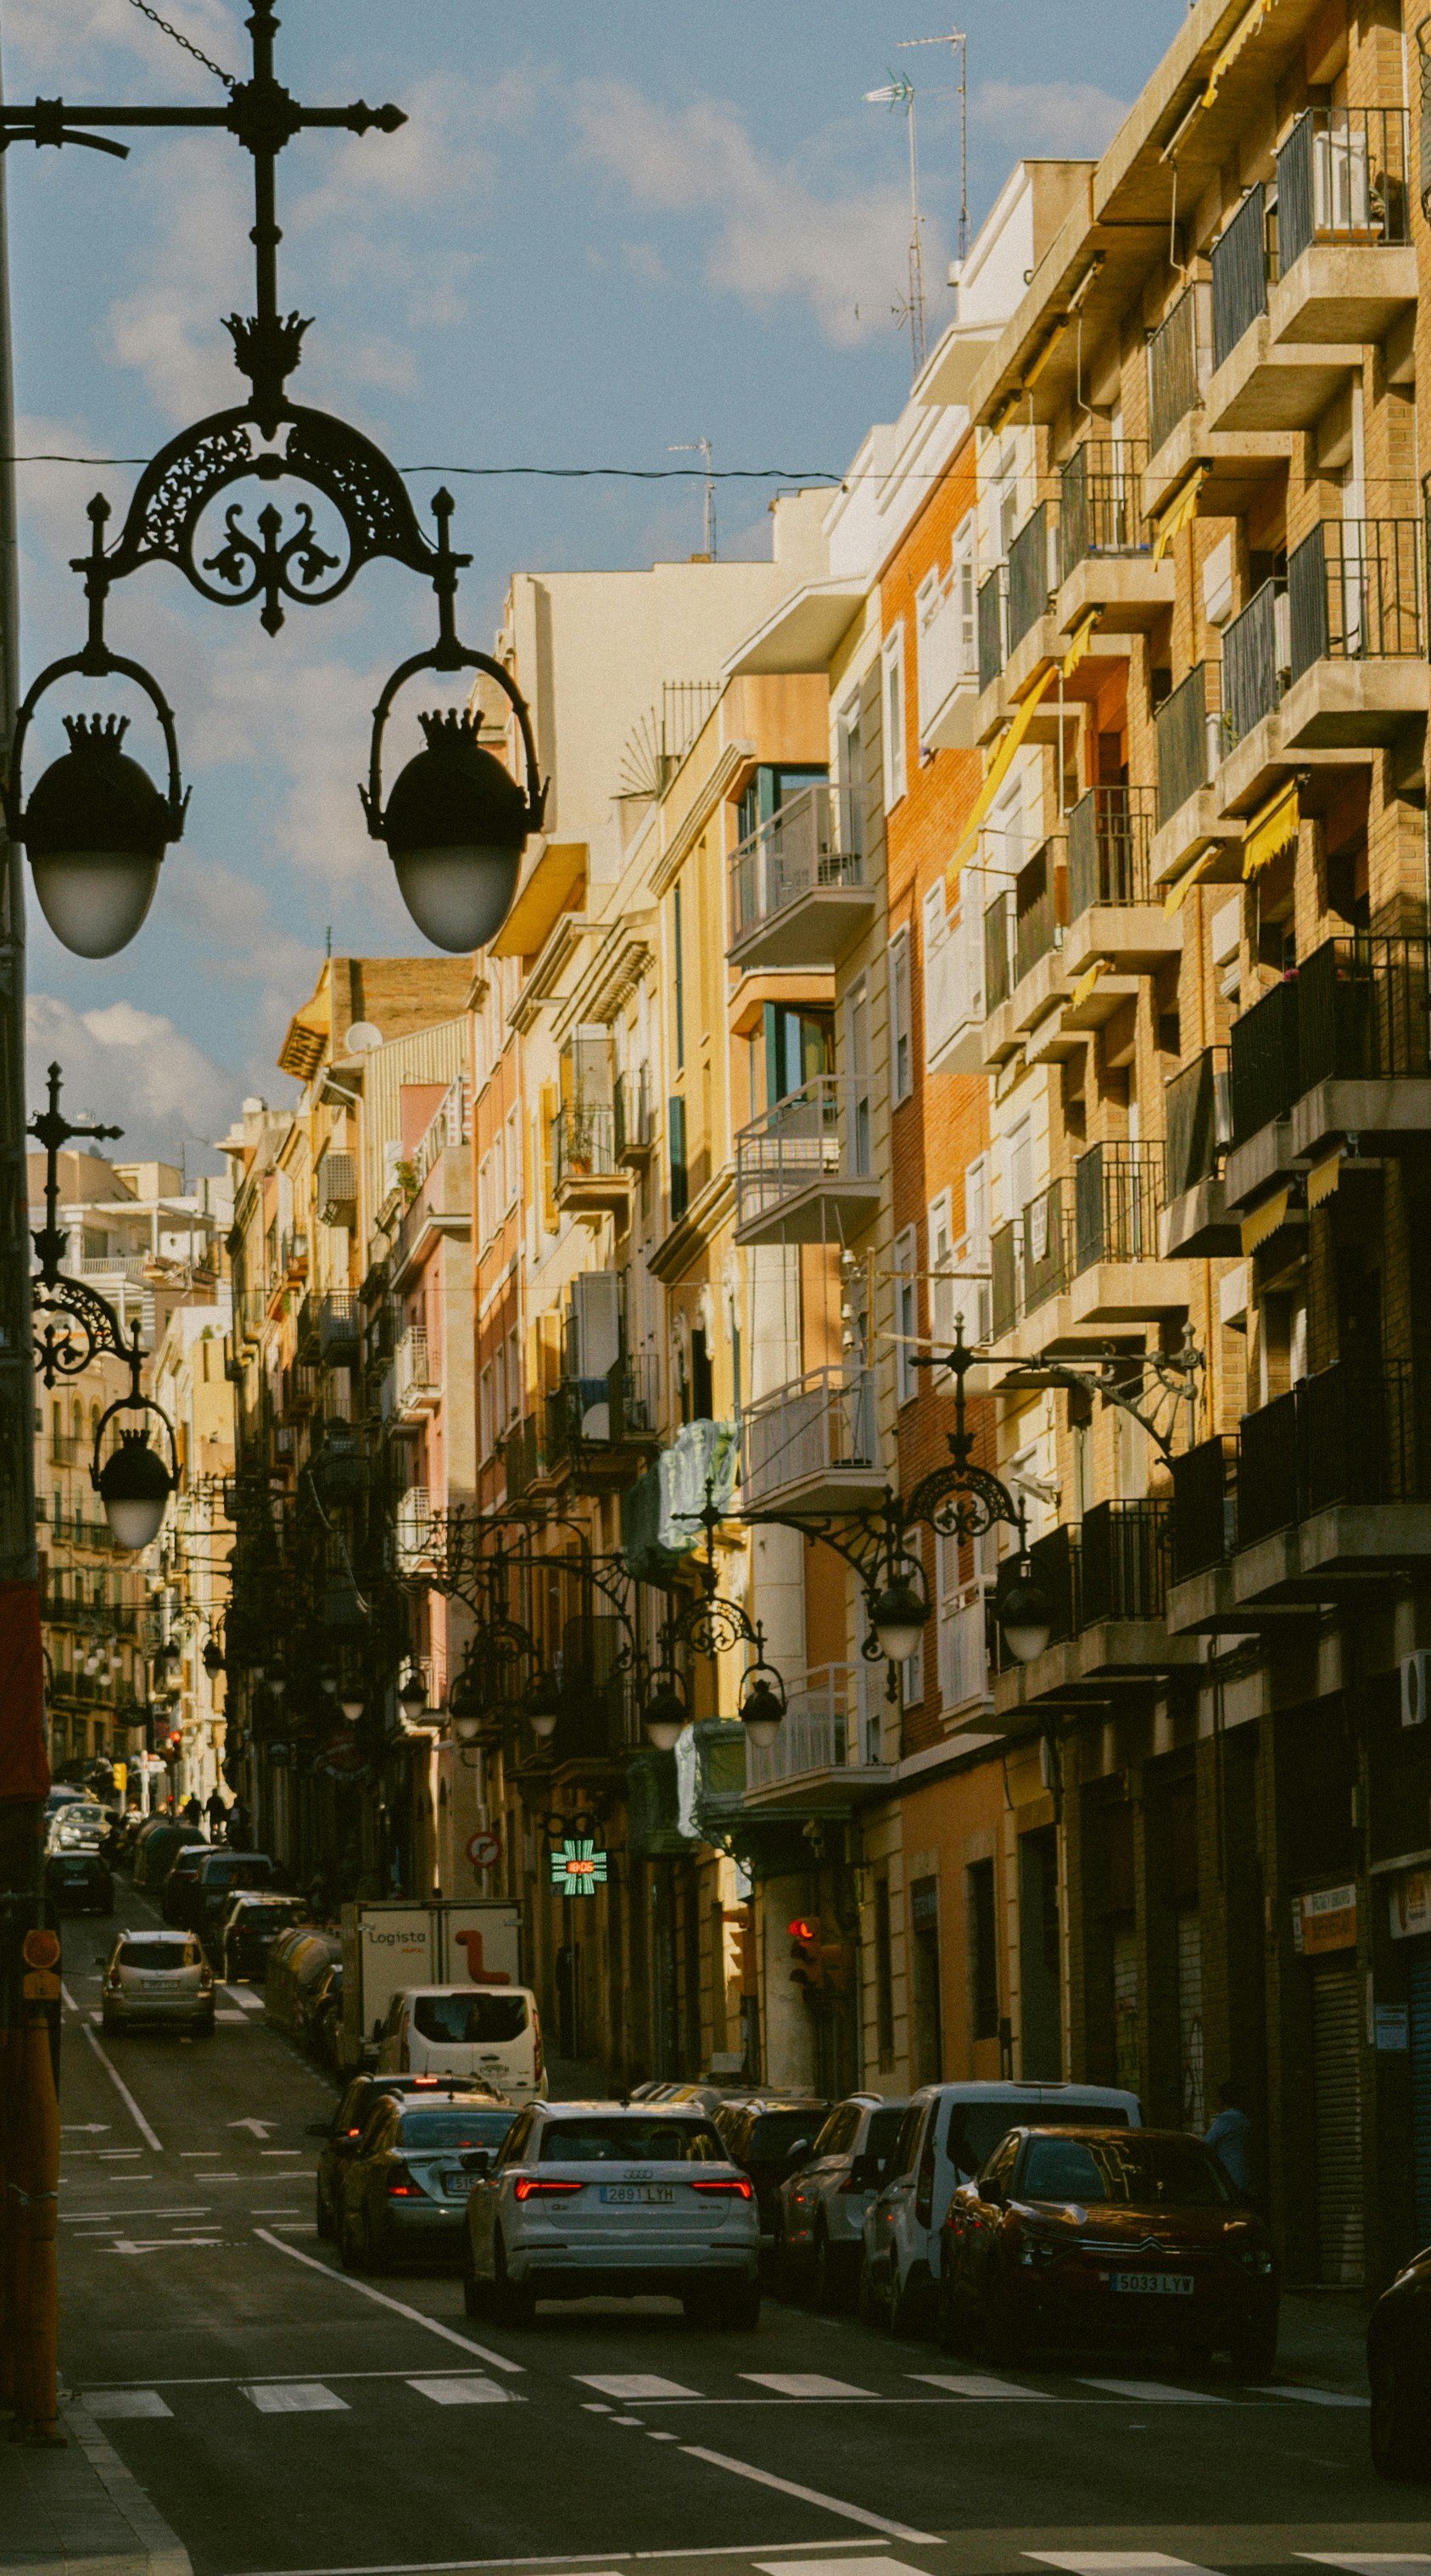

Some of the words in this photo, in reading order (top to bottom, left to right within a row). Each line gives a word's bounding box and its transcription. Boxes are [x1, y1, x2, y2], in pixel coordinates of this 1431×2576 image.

[369, 1931, 425, 1946] Logista
[609, 2188, 642, 2200] 2891
[647, 2188, 673, 2200] LYH
[1121, 2276, 1158, 2290] 5033
